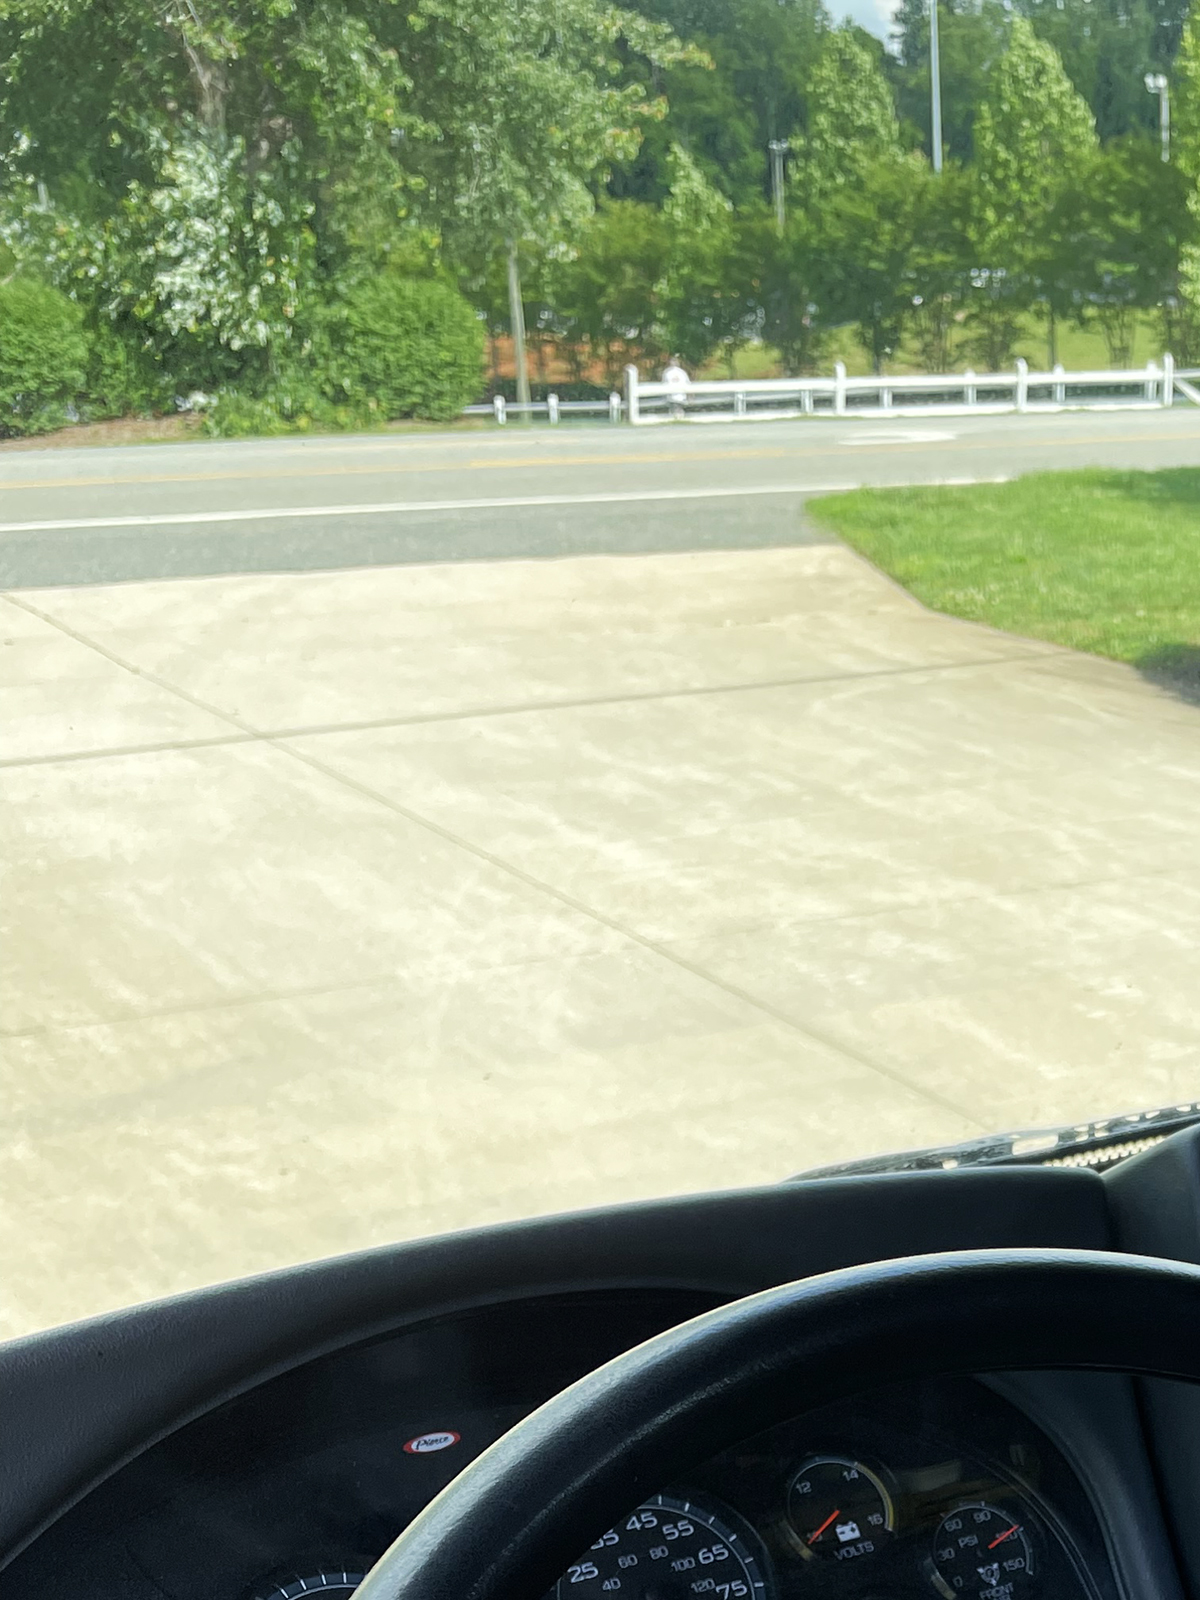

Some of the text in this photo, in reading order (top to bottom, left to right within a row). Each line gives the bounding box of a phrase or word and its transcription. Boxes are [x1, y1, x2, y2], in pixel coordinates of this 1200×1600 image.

[795, 1480, 813, 1495] 12
[624, 1511, 659, 1532] 45
[661, 1519, 695, 1541] 55
[957, 1534, 979, 1549] PSI
[648, 1544, 669, 1561] 80
[698, 1543, 730, 1565] 65
[832, 1540, 876, 1561] VOLTS
[617, 1553, 639, 1569] 60
[670, 1556, 696, 1573] 100
[1002, 1557, 1026, 1573] 150
[567, 1561, 600, 1585] 25
[602, 1576, 622, 1592] 40
[690, 1577, 716, 1594] 120
[979, 1582, 1014, 1600] FRONT
